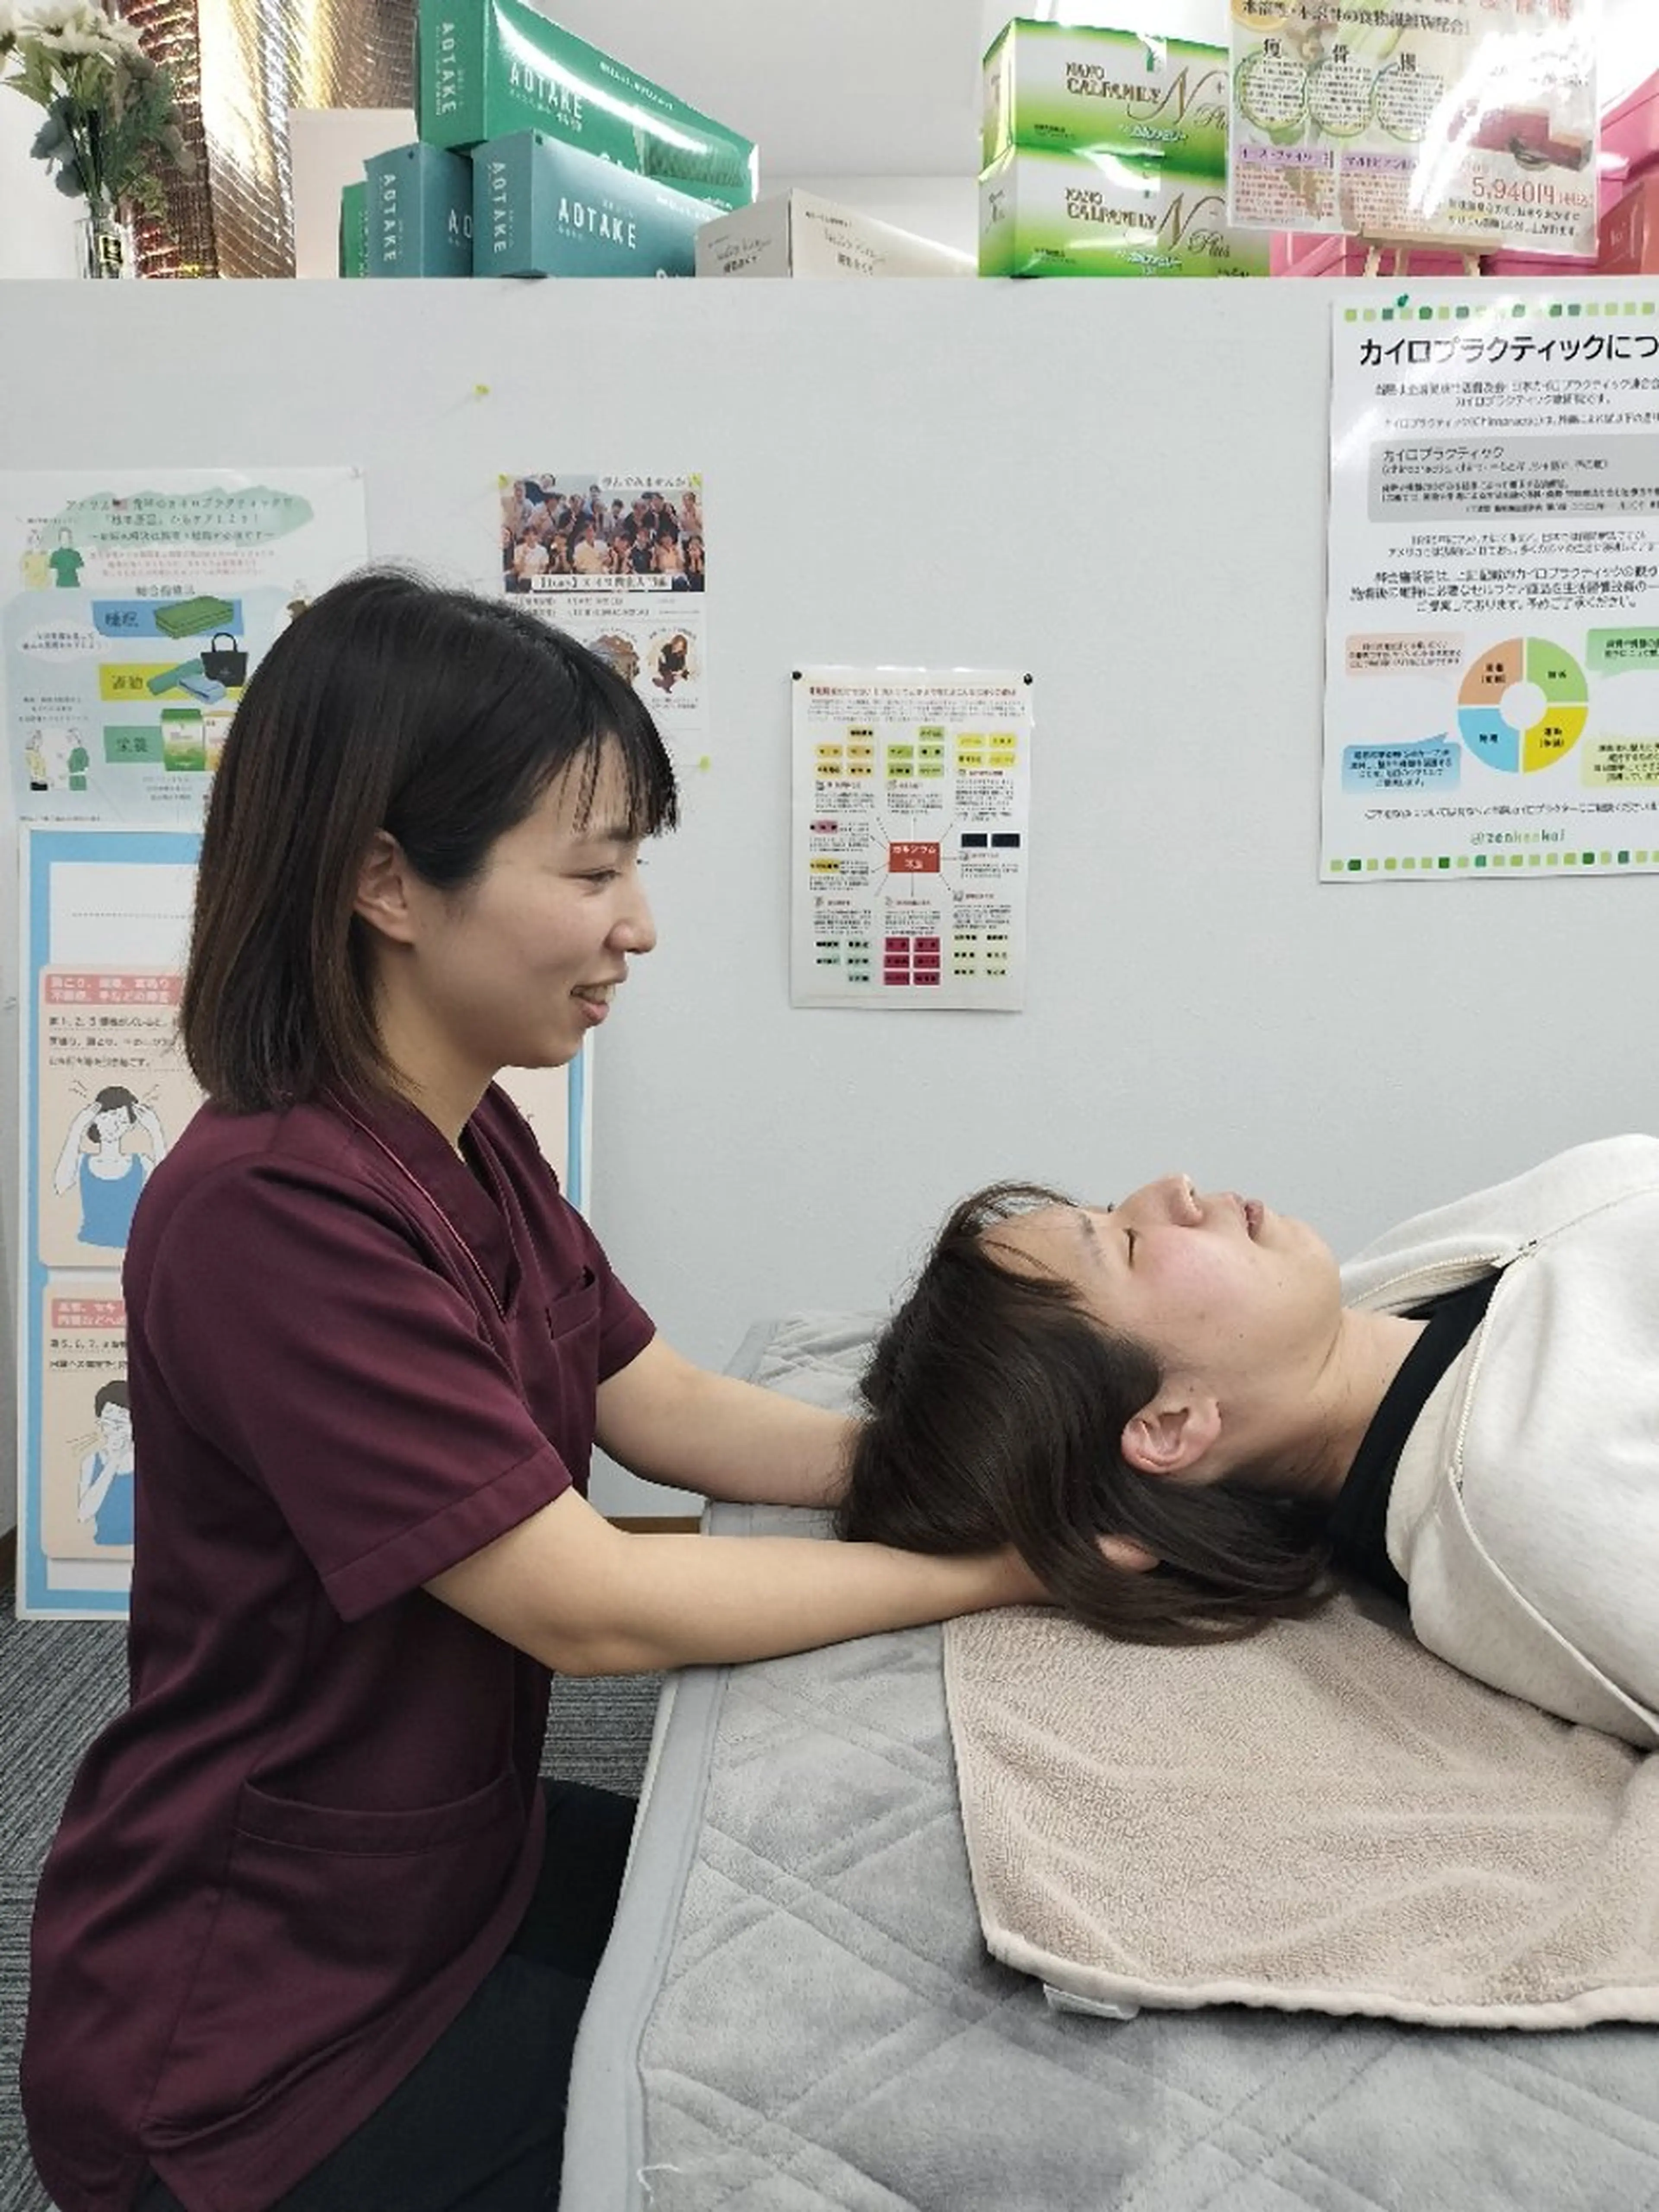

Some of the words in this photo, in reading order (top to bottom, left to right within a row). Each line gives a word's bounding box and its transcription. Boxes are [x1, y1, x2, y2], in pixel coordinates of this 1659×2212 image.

[442, 22, 456, 114] AOTAKE
[384, 174, 397, 261] AOTAKE
[492, 162, 507, 254] AOTAKE
[559, 197, 636, 250] AOTAKE
